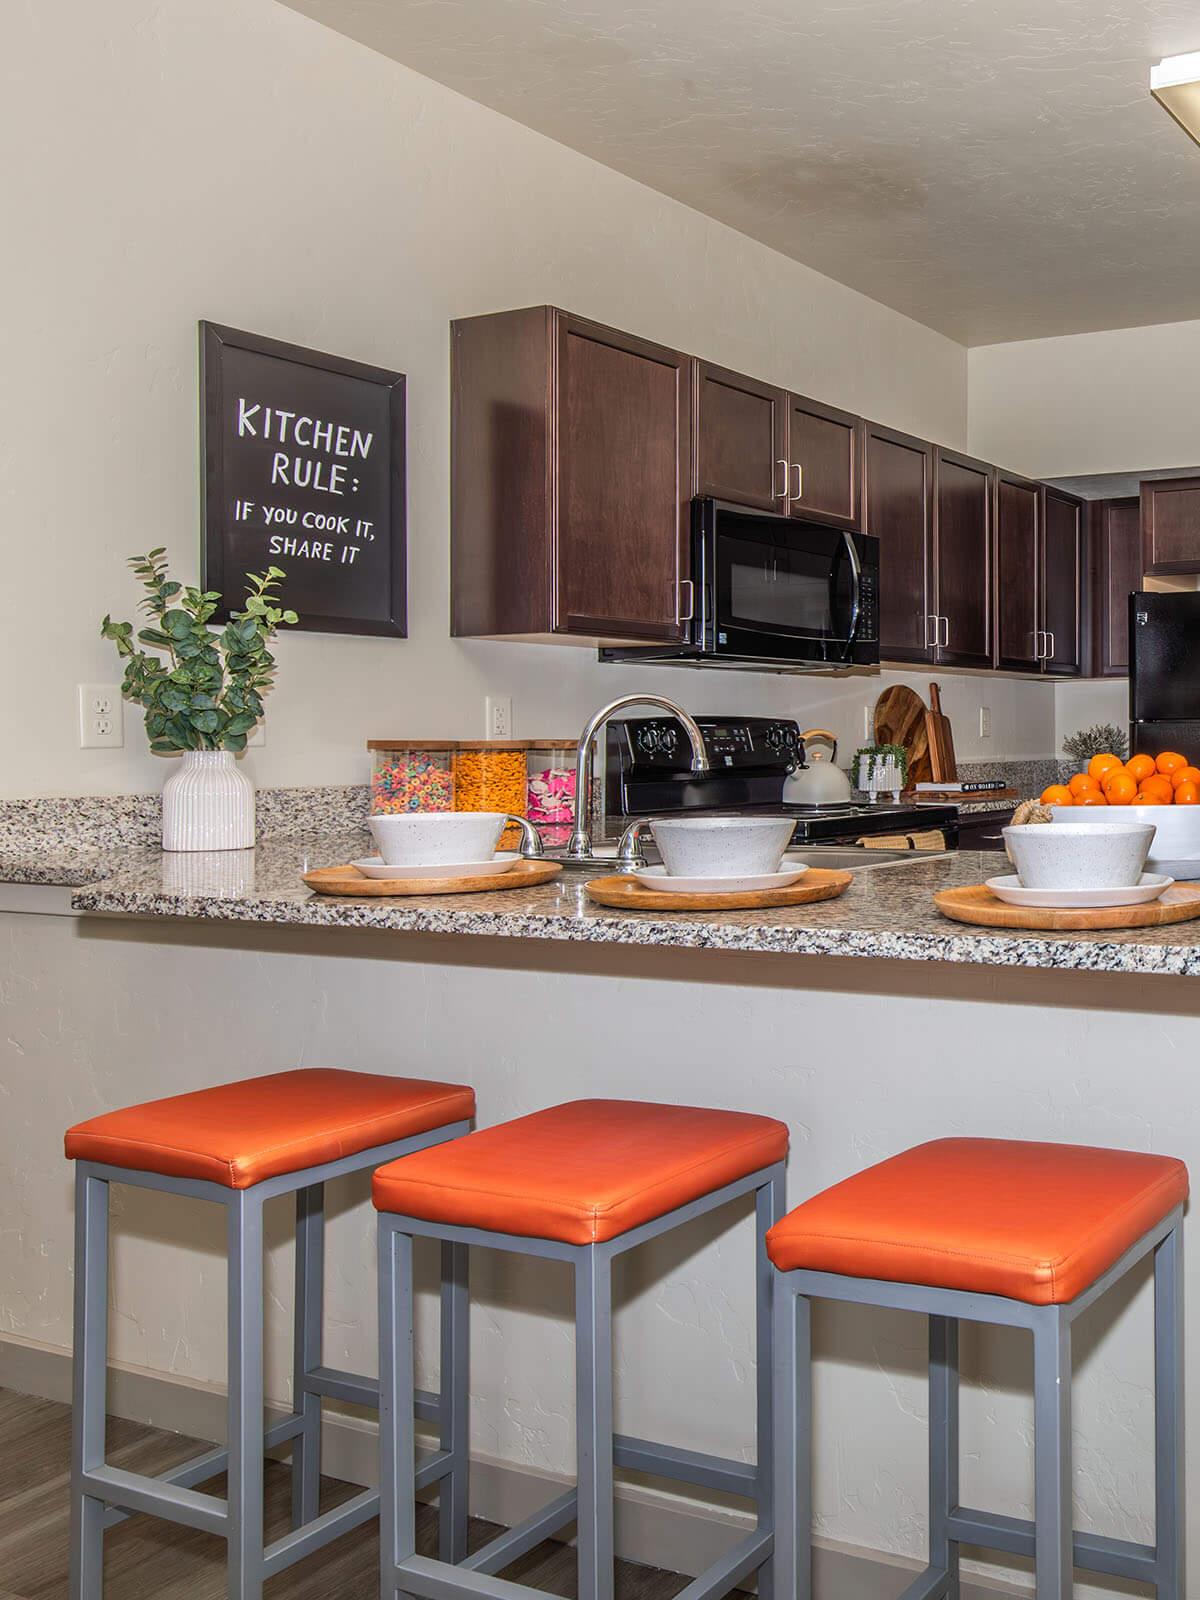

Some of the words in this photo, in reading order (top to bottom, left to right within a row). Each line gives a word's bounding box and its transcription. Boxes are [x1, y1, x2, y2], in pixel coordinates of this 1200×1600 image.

[238, 398, 373, 459] KITCHEN
[271, 452, 359, 496] RULE:
[235, 500, 255, 521] IF
[262, 505, 297, 525] YOU
[302, 511, 350, 534] COOK
[355, 519, 375, 541] IT,
[269, 535, 333, 561] SHARE
[341, 545, 360, 564] IT
